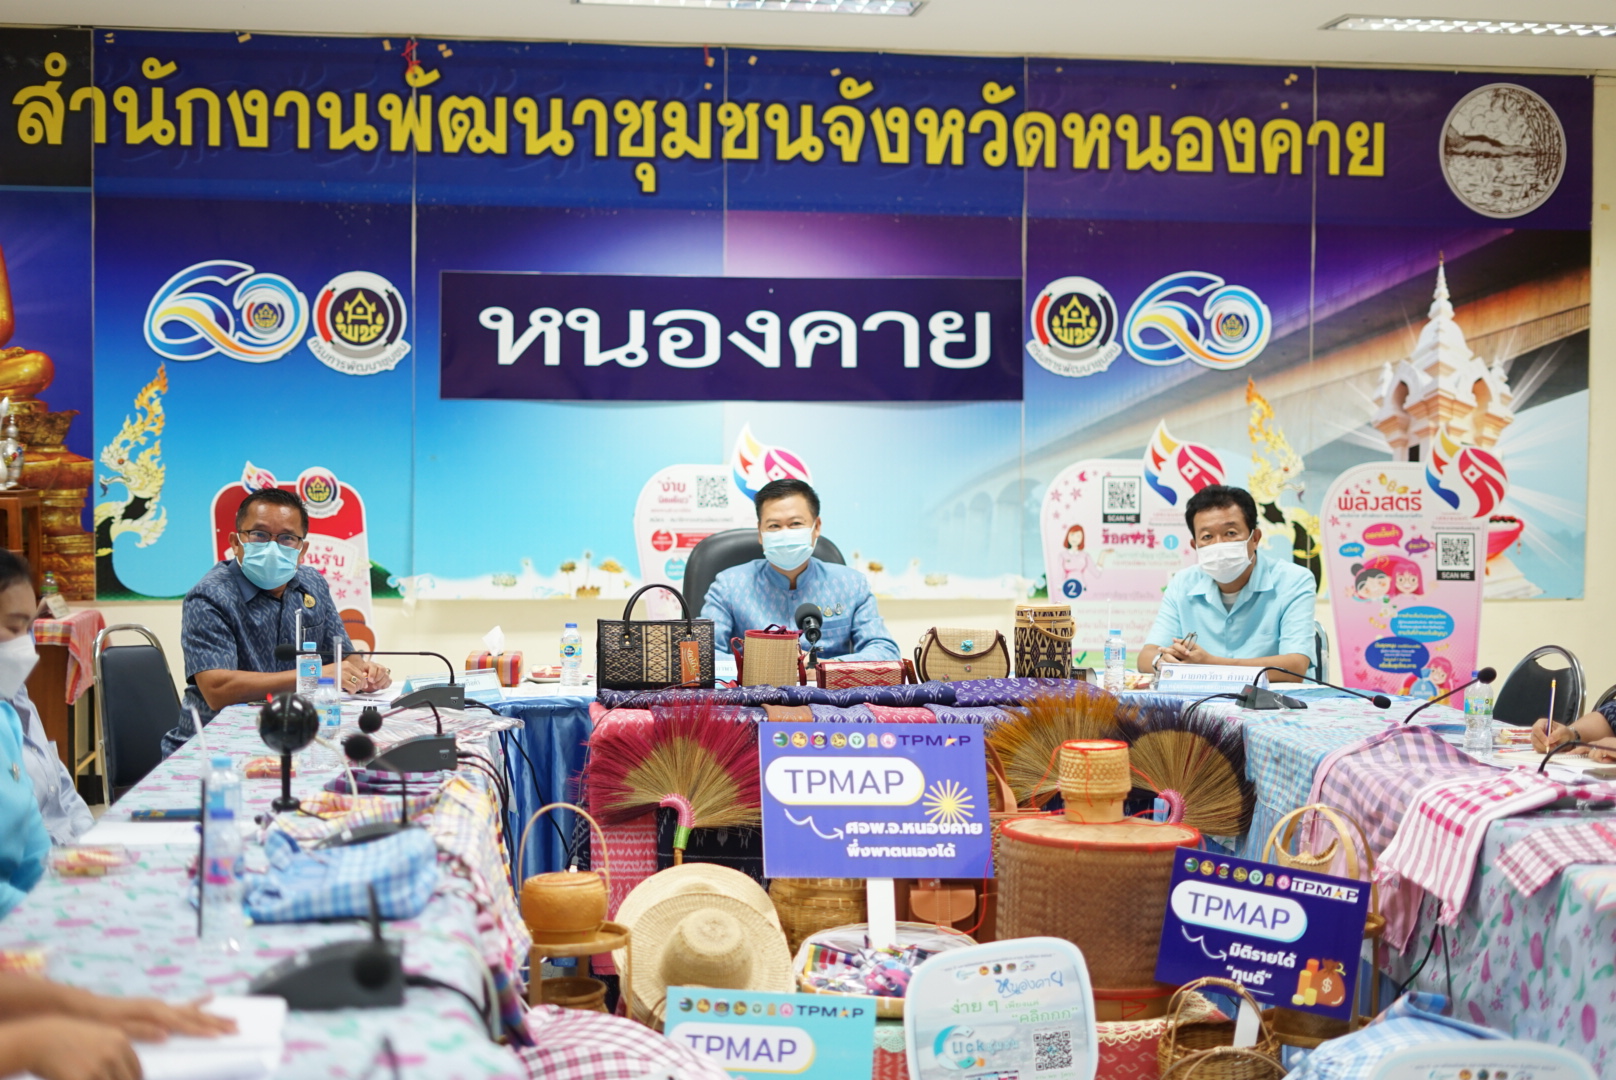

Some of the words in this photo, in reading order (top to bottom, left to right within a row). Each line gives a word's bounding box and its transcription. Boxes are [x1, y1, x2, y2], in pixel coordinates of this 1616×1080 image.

[12, 51, 1386, 193] สำนักงานพัฒนาชุมชนจังหวัดหนองคาย
[479, 305, 992, 371] หนองคาย
[310, 338, 408, 373] กรมการพัฒนาชุมชน
[1337, 488, 1422, 511] พลังสตรี
[1067, 582, 1078, 596] 2
[784, 769, 905, 795] TPMAP
[846, 838, 957, 859] พึ่งพาตนเองได้
[1188, 891, 1291, 931] TPMAP
[1229, 942, 1297, 969] มิติรายได้
[951, 999, 983, 1014] ง่าย
[685, 1034, 798, 1063] TPMAP
